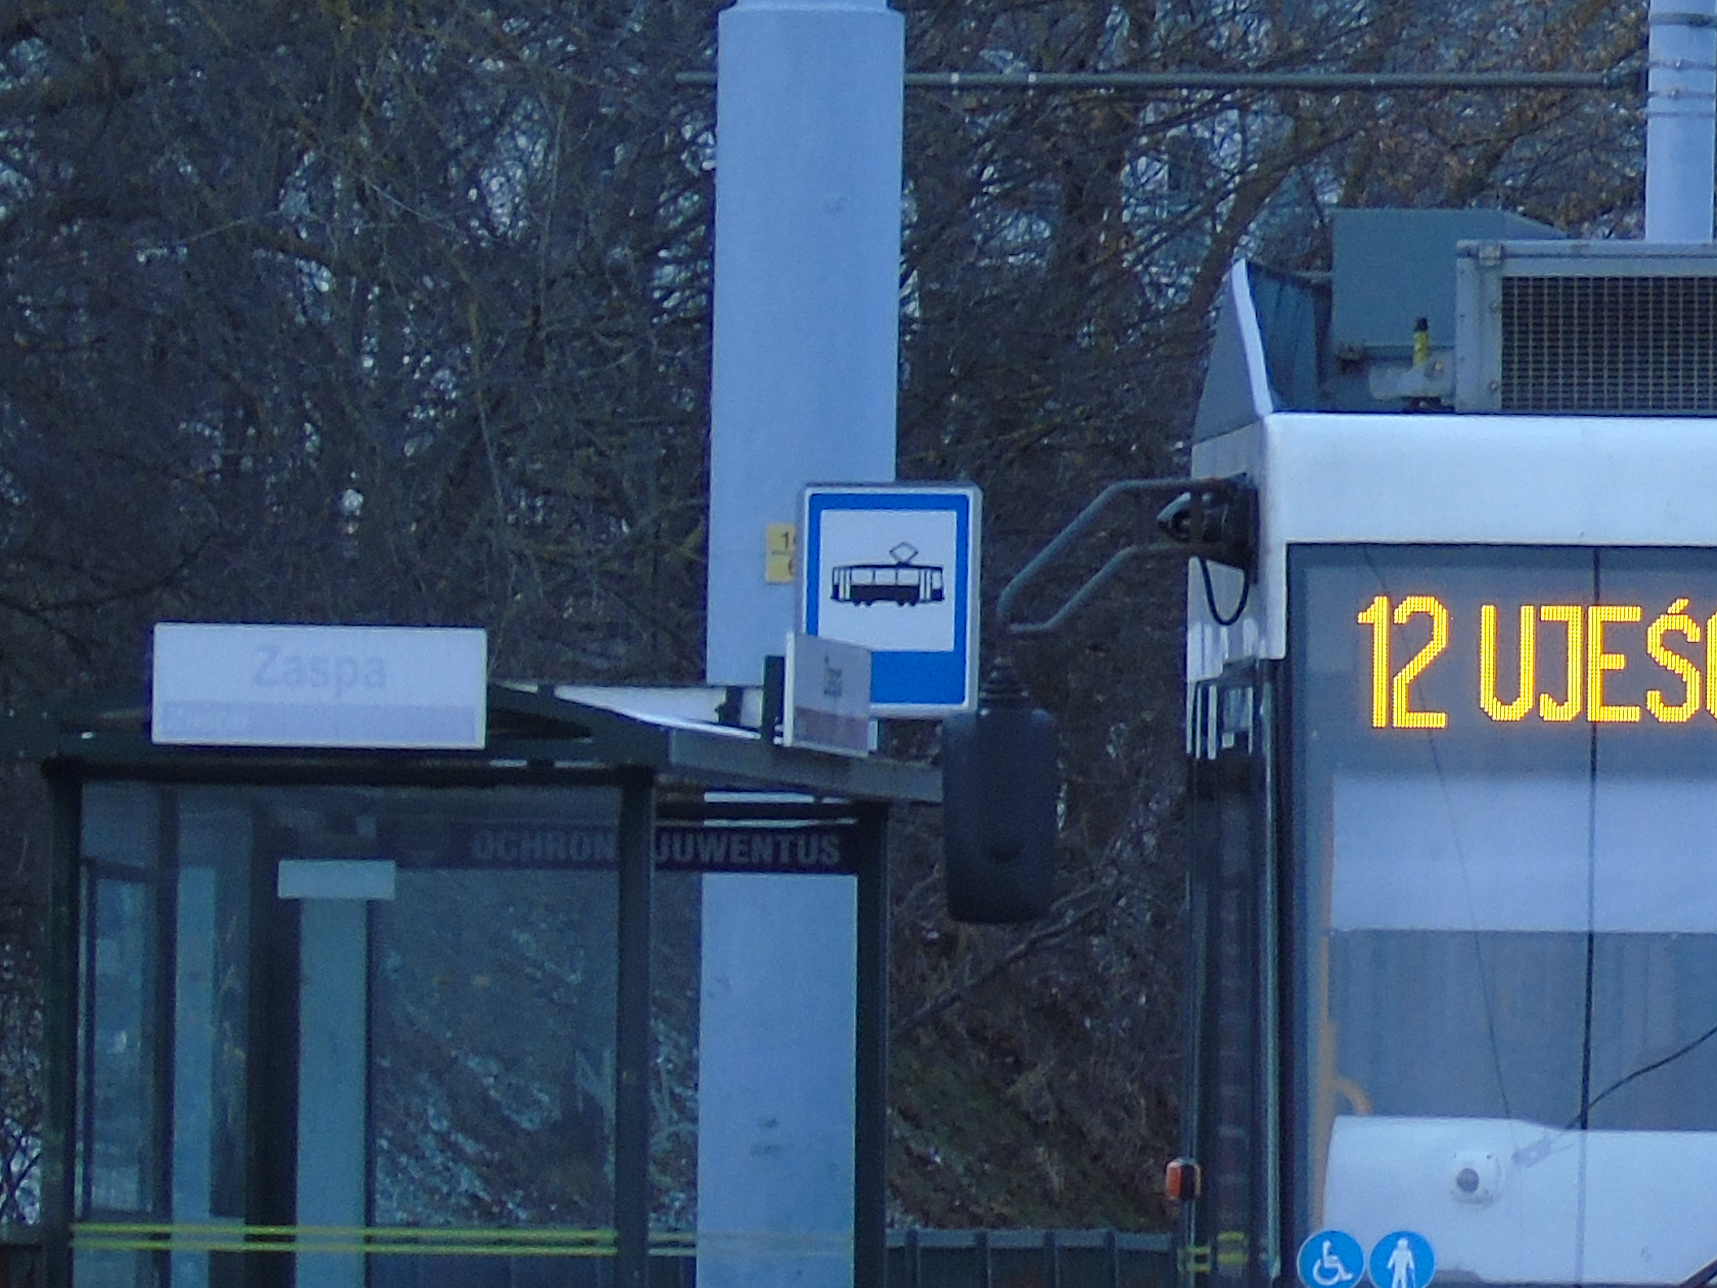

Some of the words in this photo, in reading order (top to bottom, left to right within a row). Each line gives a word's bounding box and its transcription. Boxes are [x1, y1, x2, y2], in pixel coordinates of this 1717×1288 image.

[253, 644, 387, 699] Zaspa
[1358, 595, 1449, 729] 12
[472, 828, 619, 863] OCHRON
[653, 832, 841, 866] JUWENTUS
